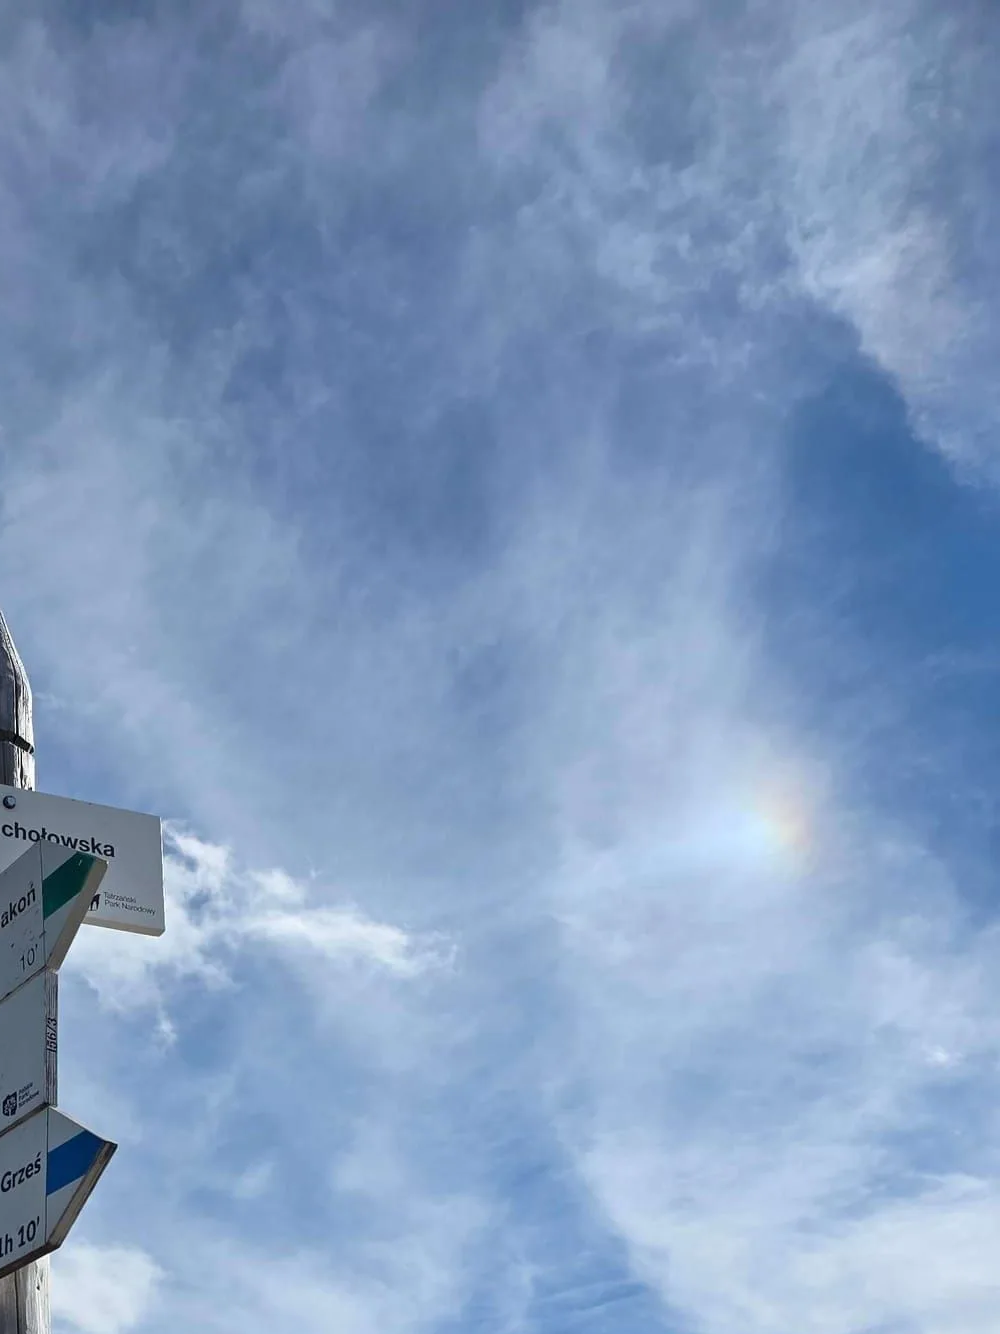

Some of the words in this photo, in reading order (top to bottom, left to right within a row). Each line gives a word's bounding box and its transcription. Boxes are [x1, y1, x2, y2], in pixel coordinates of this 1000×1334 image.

[20, 943, 38, 971] 10'
[0, 1151, 42, 1193] Grześ
[18, 1215, 40, 1248] 10'
